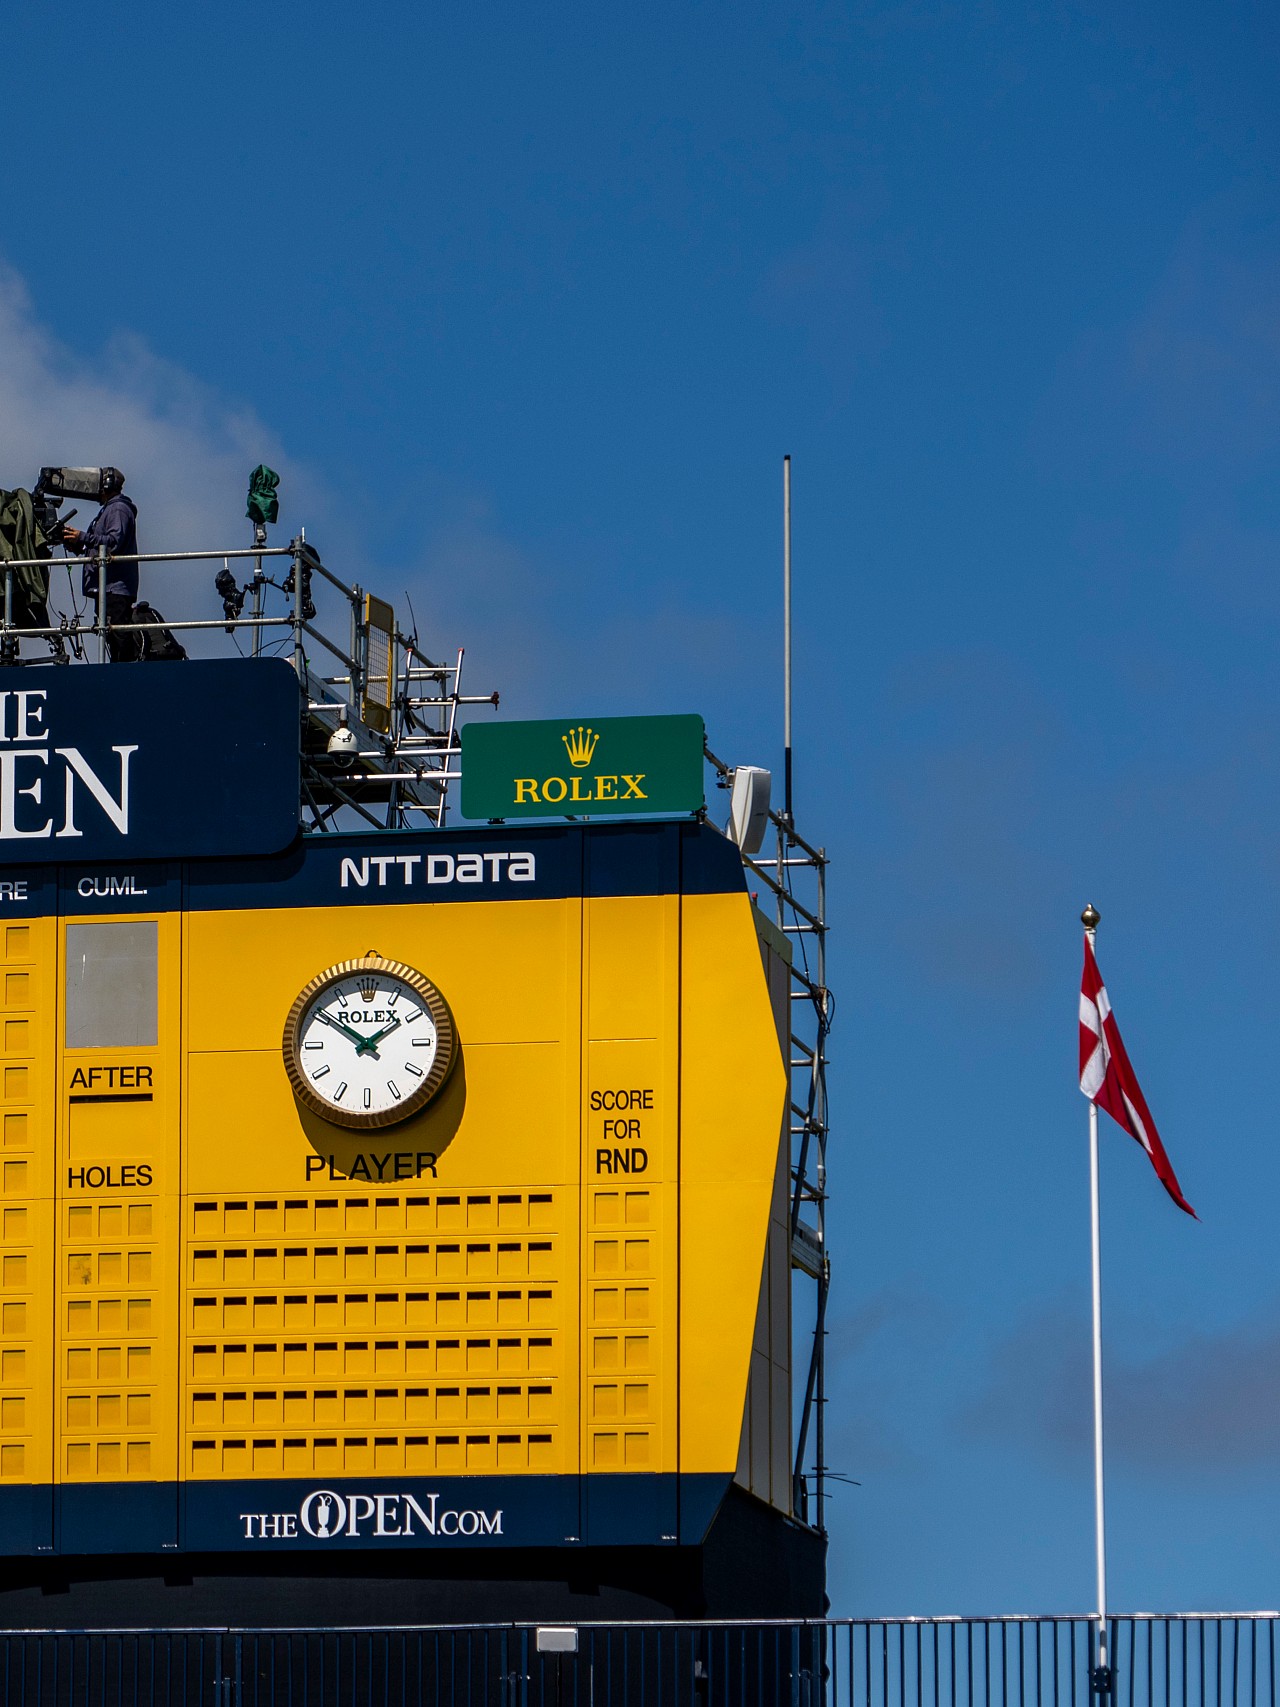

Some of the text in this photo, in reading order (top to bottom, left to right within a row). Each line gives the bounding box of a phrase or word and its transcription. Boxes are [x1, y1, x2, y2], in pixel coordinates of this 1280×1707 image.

[513, 774, 648, 804] ROLEX
[341, 854, 421, 887] NTT
[77, 876, 148, 897] CUML.
[338, 1010, 399, 1023] ROLEX
[69, 1066, 153, 1089] AFTER
[590, 1089, 654, 1111] SCORE
[603, 1119, 641, 1140] FOR
[306, 1152, 438, 1181] PLAYER
[596, 1147, 648, 1174] RND
[68, 1165, 153, 1189] HOLES
